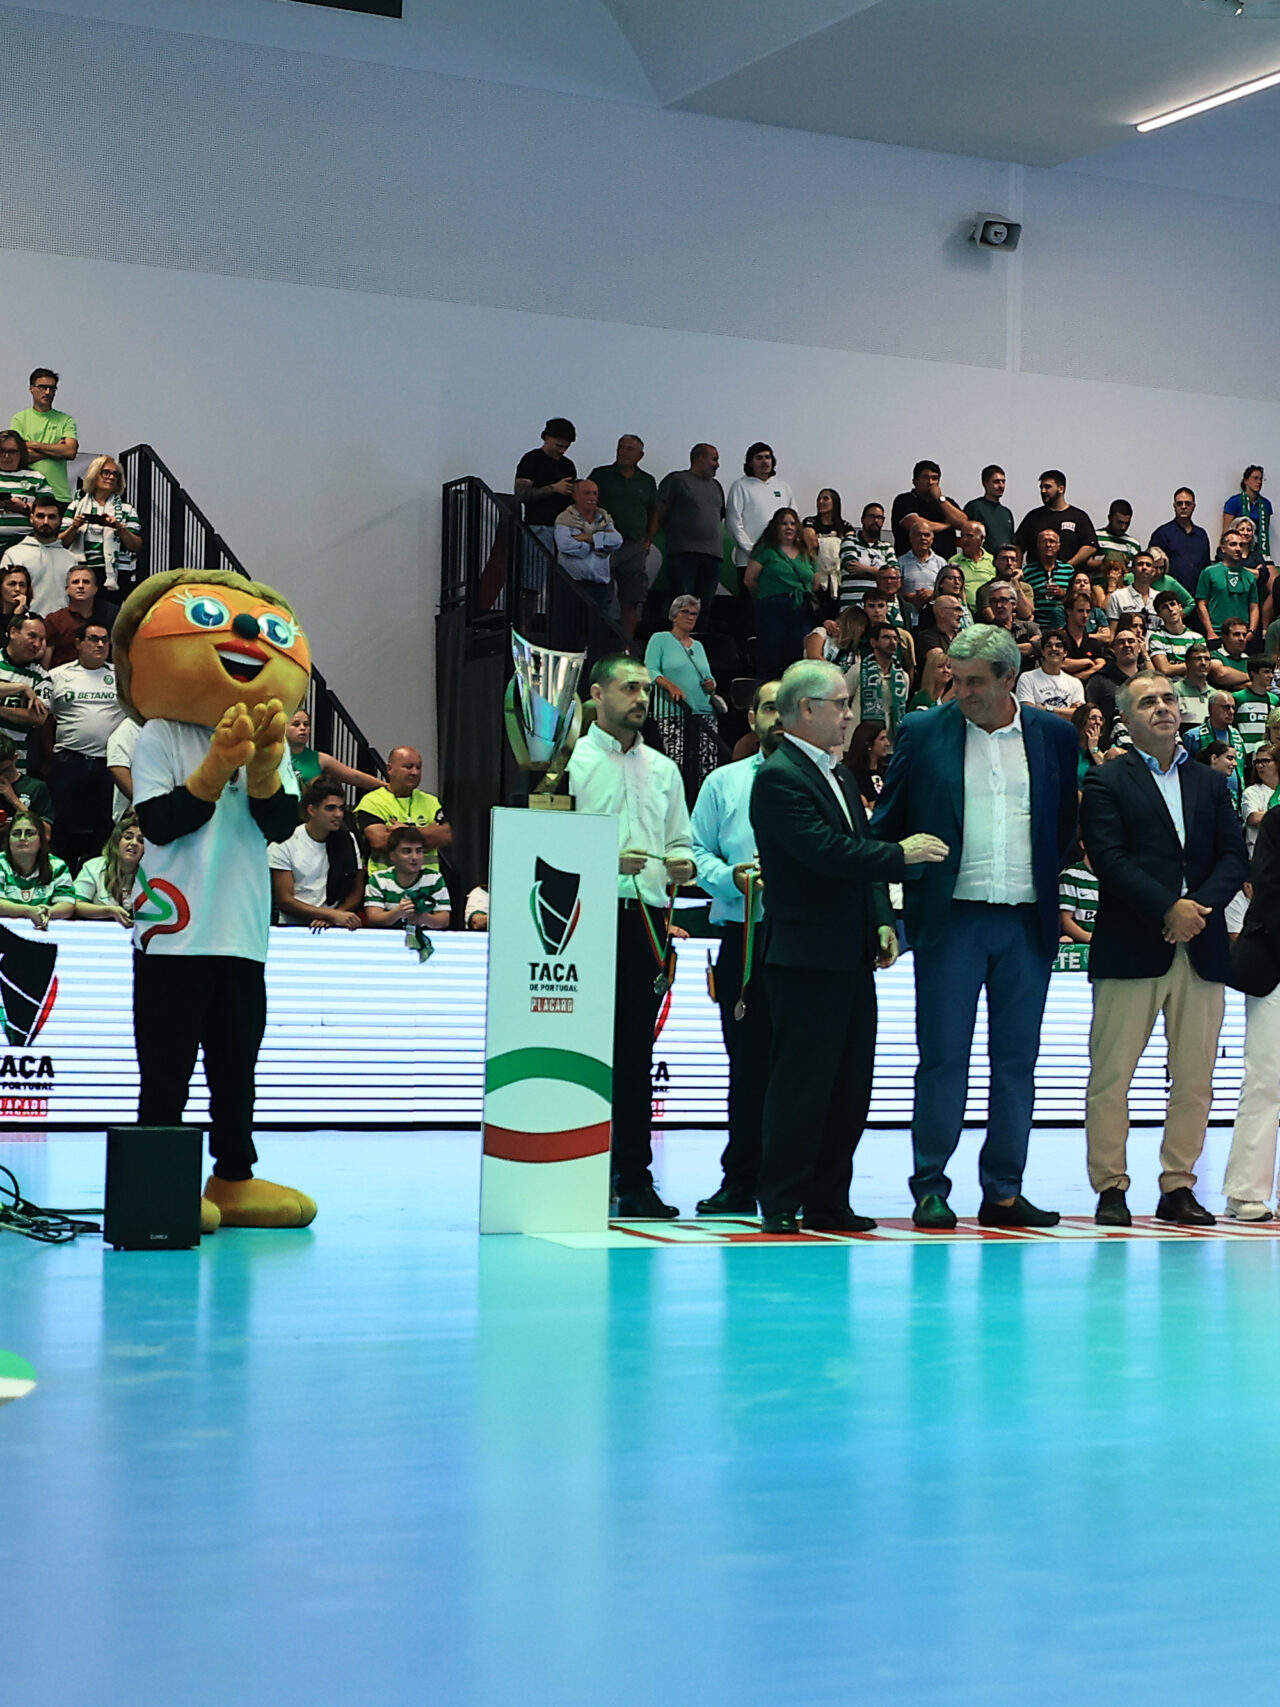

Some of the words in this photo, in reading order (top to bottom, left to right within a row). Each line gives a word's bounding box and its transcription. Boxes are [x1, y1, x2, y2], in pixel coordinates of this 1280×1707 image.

[77, 691, 115, 699] BETANO
[541, 984, 578, 992] PORTUGAL
[0, 1055, 55, 1079] AÇA
